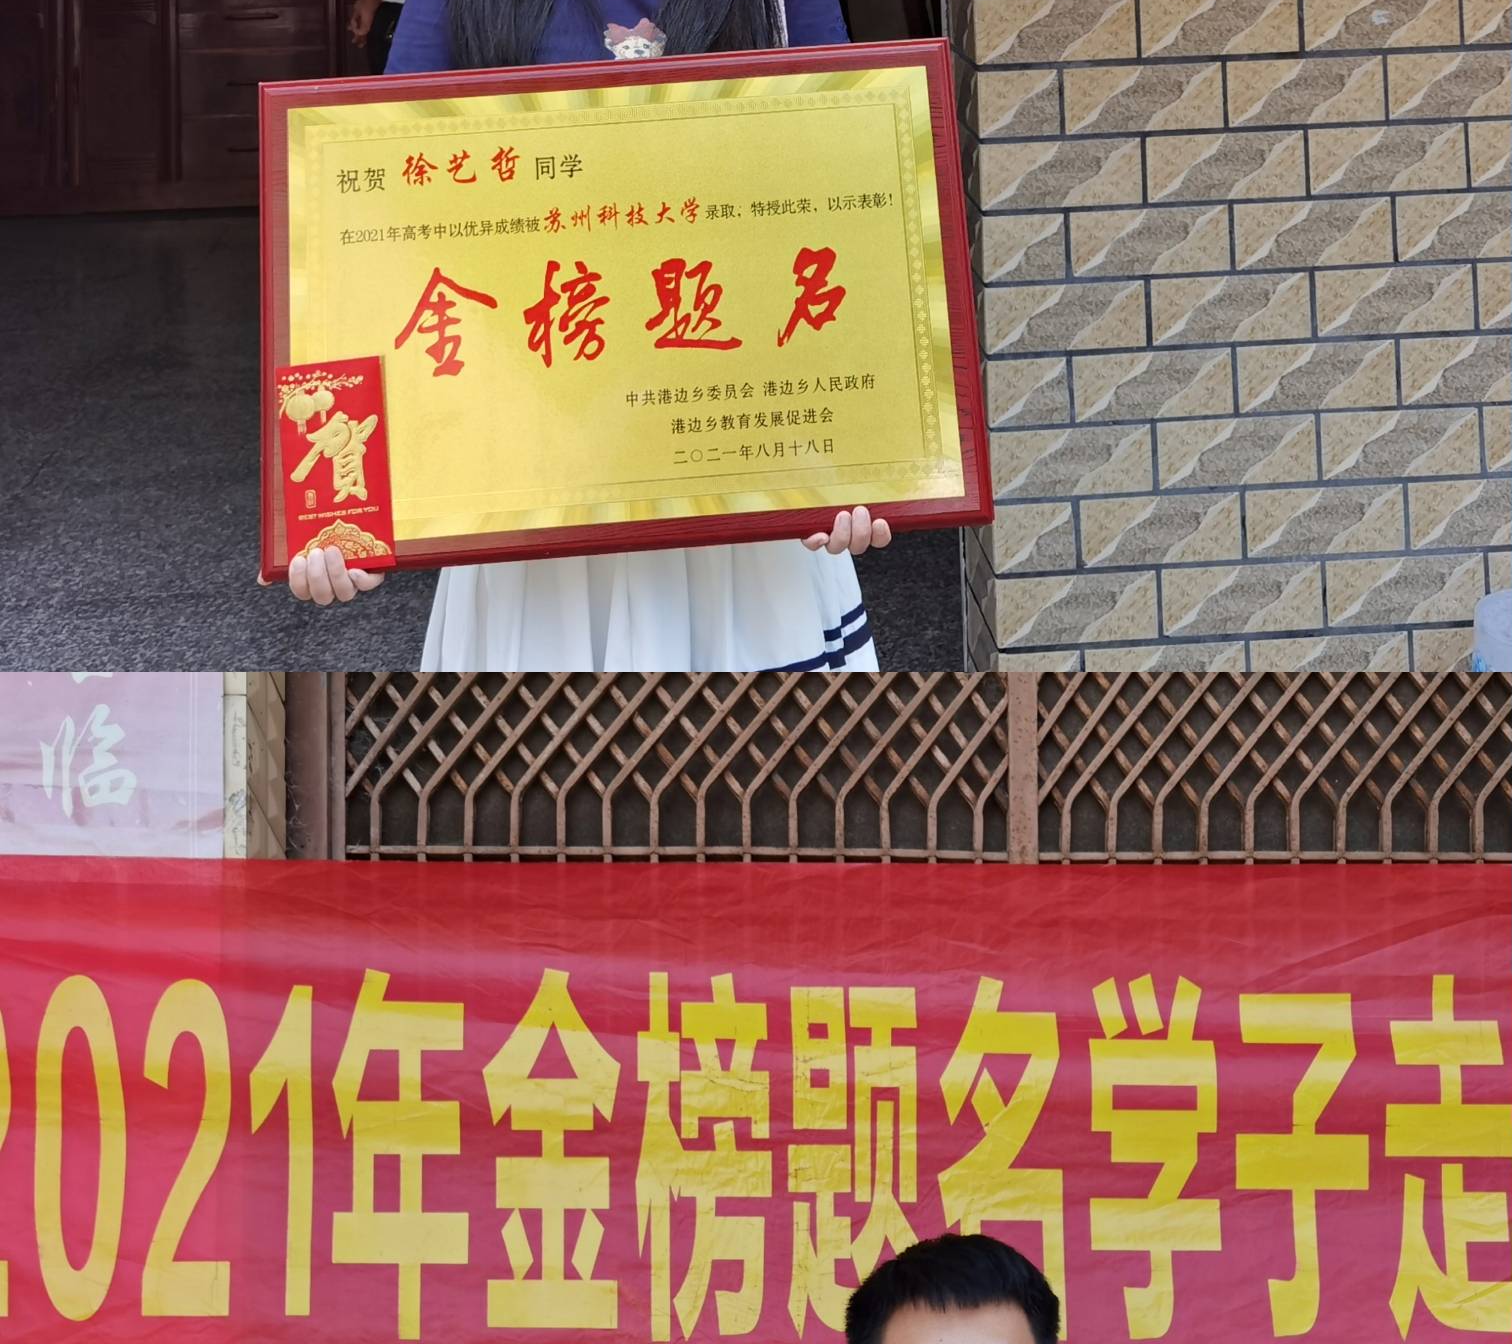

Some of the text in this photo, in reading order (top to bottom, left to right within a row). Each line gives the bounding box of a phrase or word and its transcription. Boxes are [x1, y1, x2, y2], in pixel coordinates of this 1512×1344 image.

[336, 146, 583, 194] 祝贺 徐艺哲 同学
[394, 246, 847, 378] 金榜题名
[625, 373, 875, 407] 中共港边乡委员会 港边乡人民政府
[671, 407, 834, 434] 港边乡教育发展促进会
[40, 672, 138, 819] 临
[0, 968, 1512, 1342] 021年金榜题名学子走
